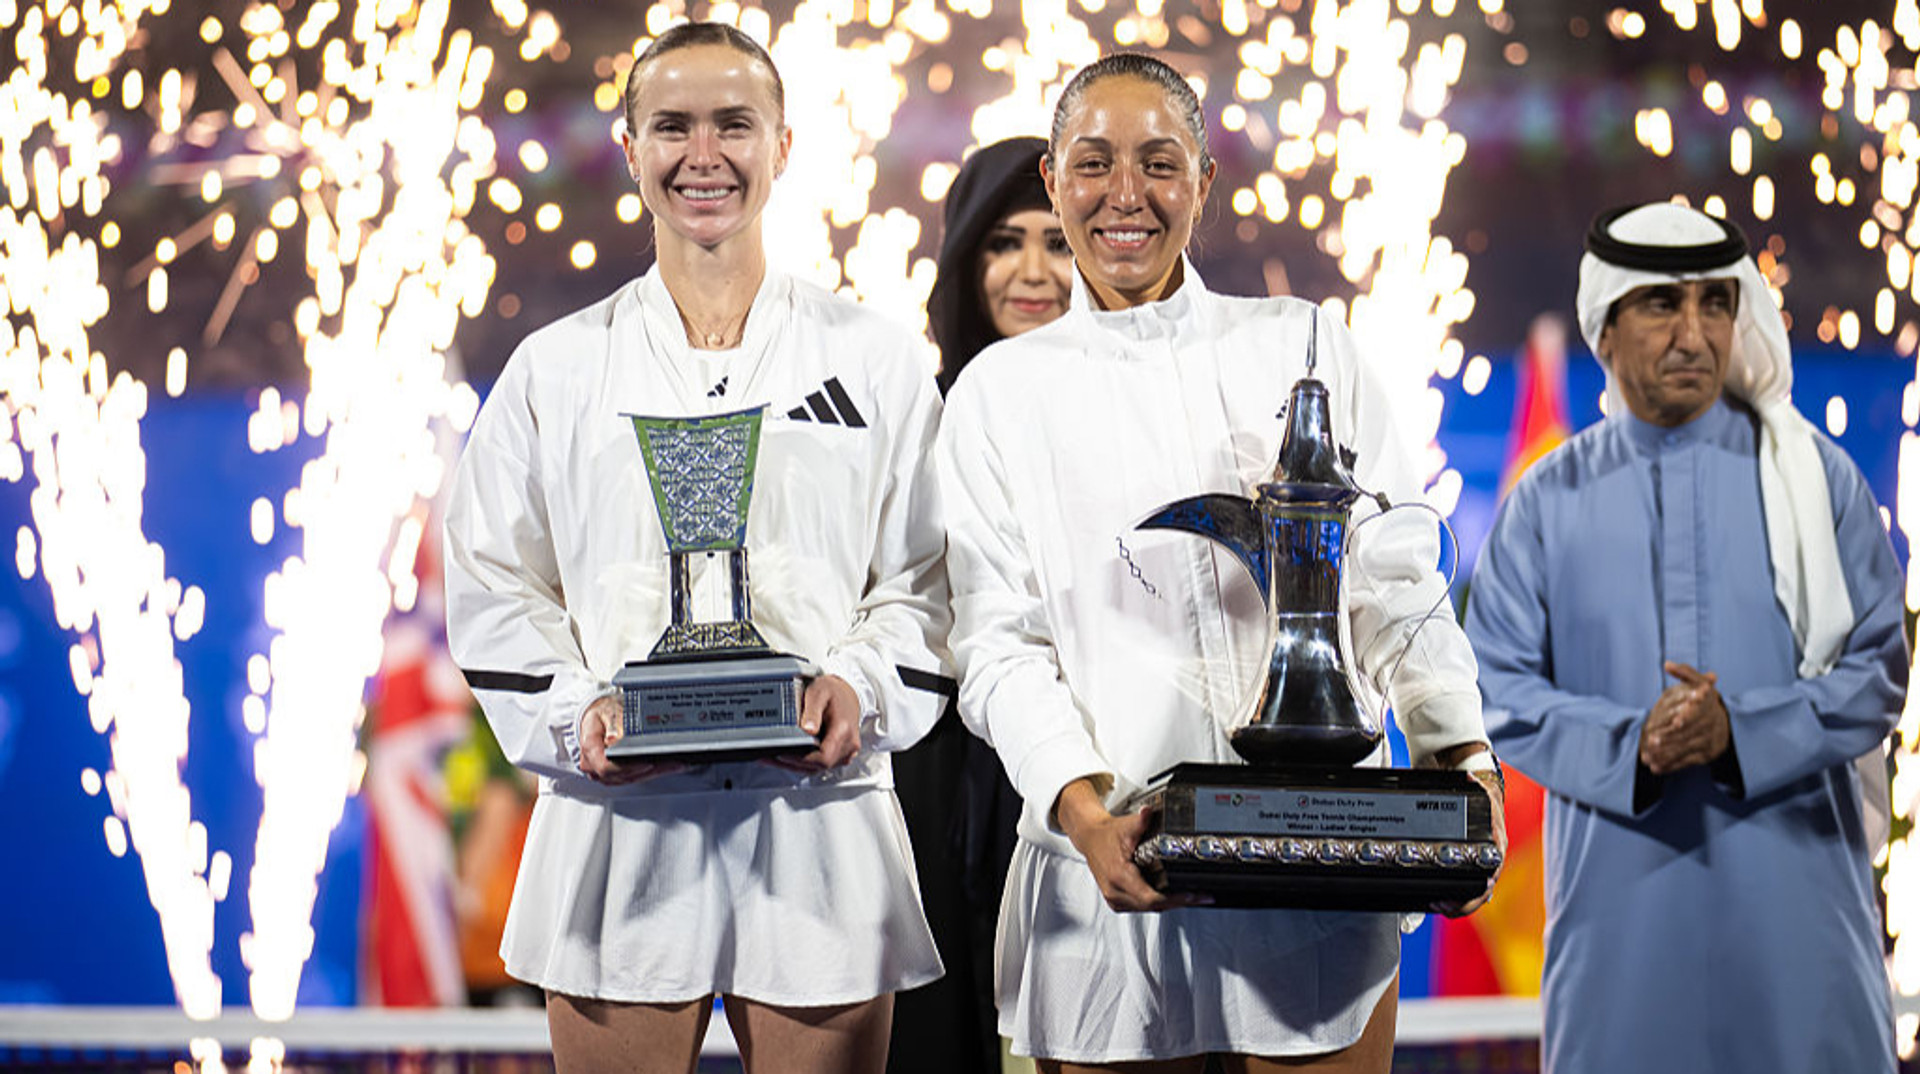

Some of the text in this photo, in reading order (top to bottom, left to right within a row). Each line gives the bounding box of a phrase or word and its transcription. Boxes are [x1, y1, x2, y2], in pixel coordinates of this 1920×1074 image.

[1337, 798, 1355, 807] Duty
[1416, 800, 1439, 811] WTA
[1258, 810, 1405, 824] Dubai Duty Free Tennis Championships
[1287, 822, 1313, 830] Winner
